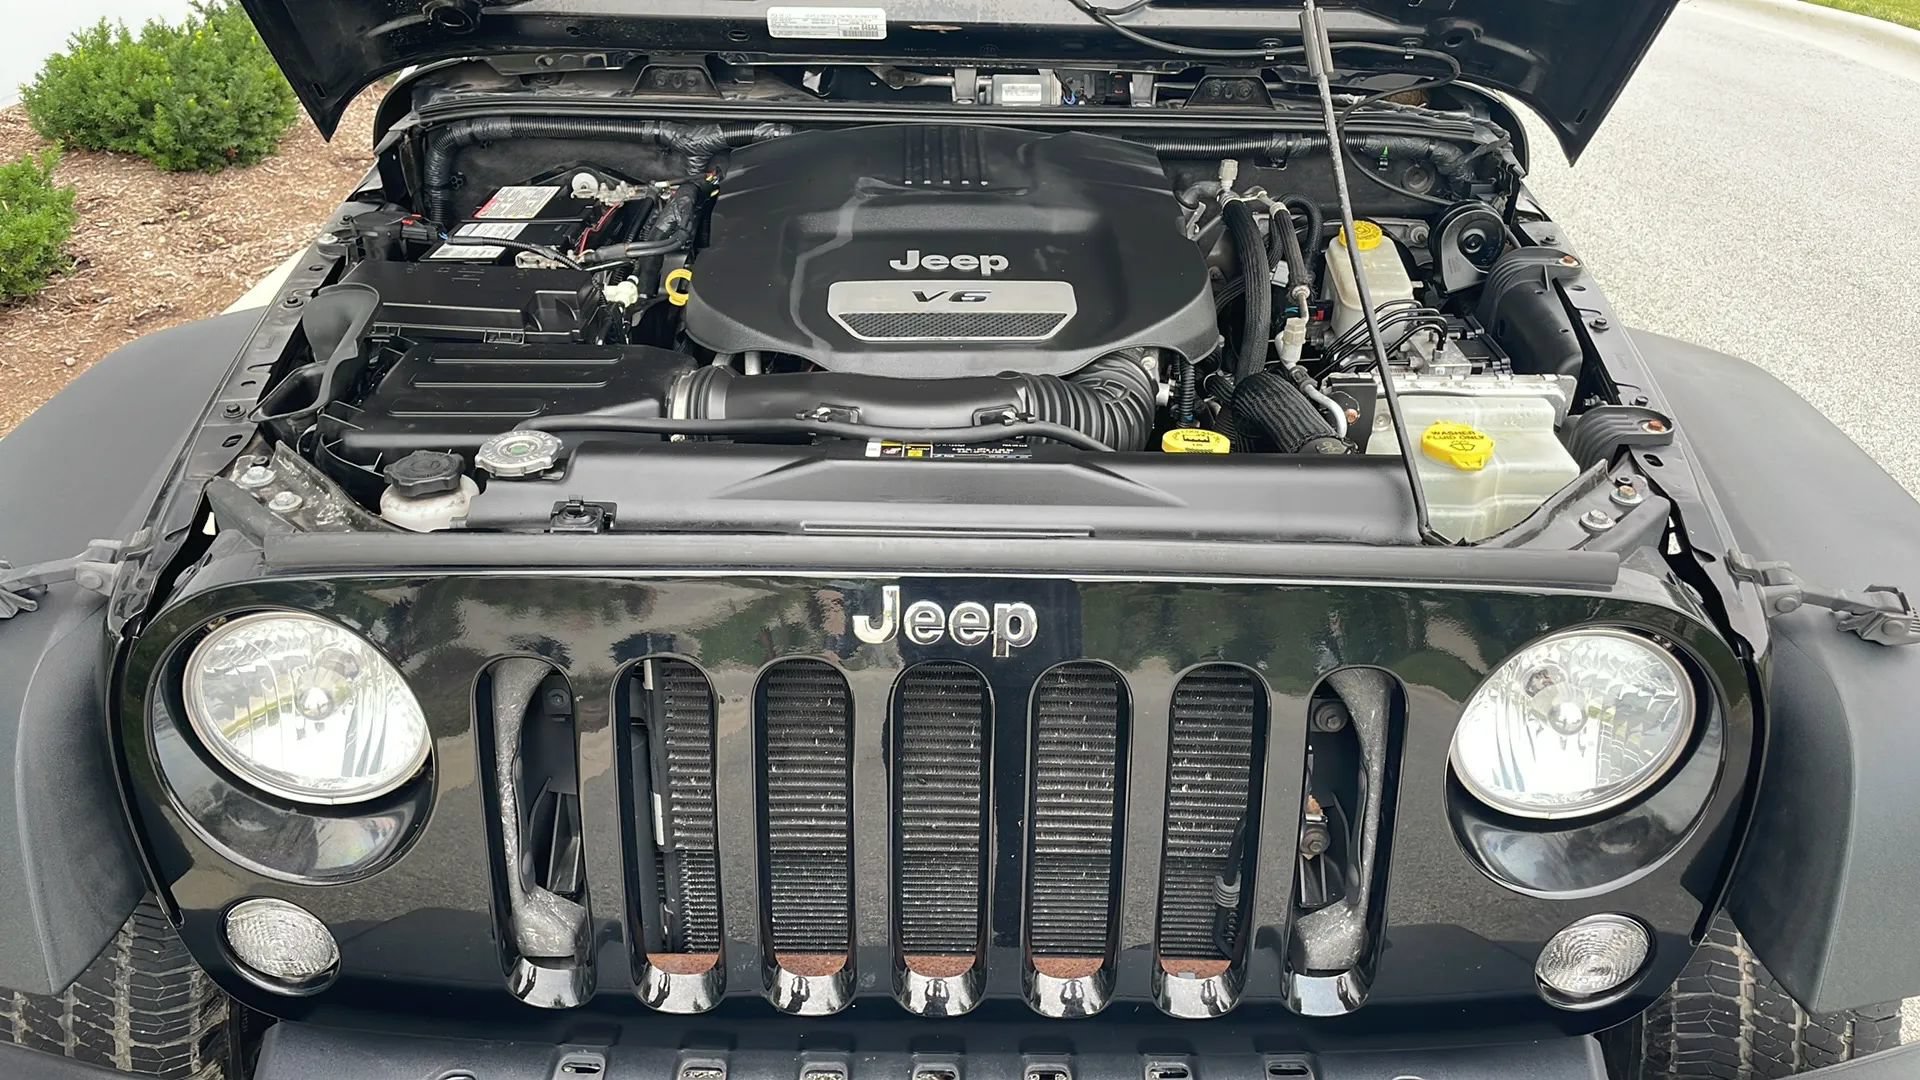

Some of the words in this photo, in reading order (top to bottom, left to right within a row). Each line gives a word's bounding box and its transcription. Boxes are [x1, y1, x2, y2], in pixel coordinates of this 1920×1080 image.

[889, 249, 1009, 276] Jeep
[912, 290, 992, 302] V6
[852, 585, 1038, 658] Jeep
